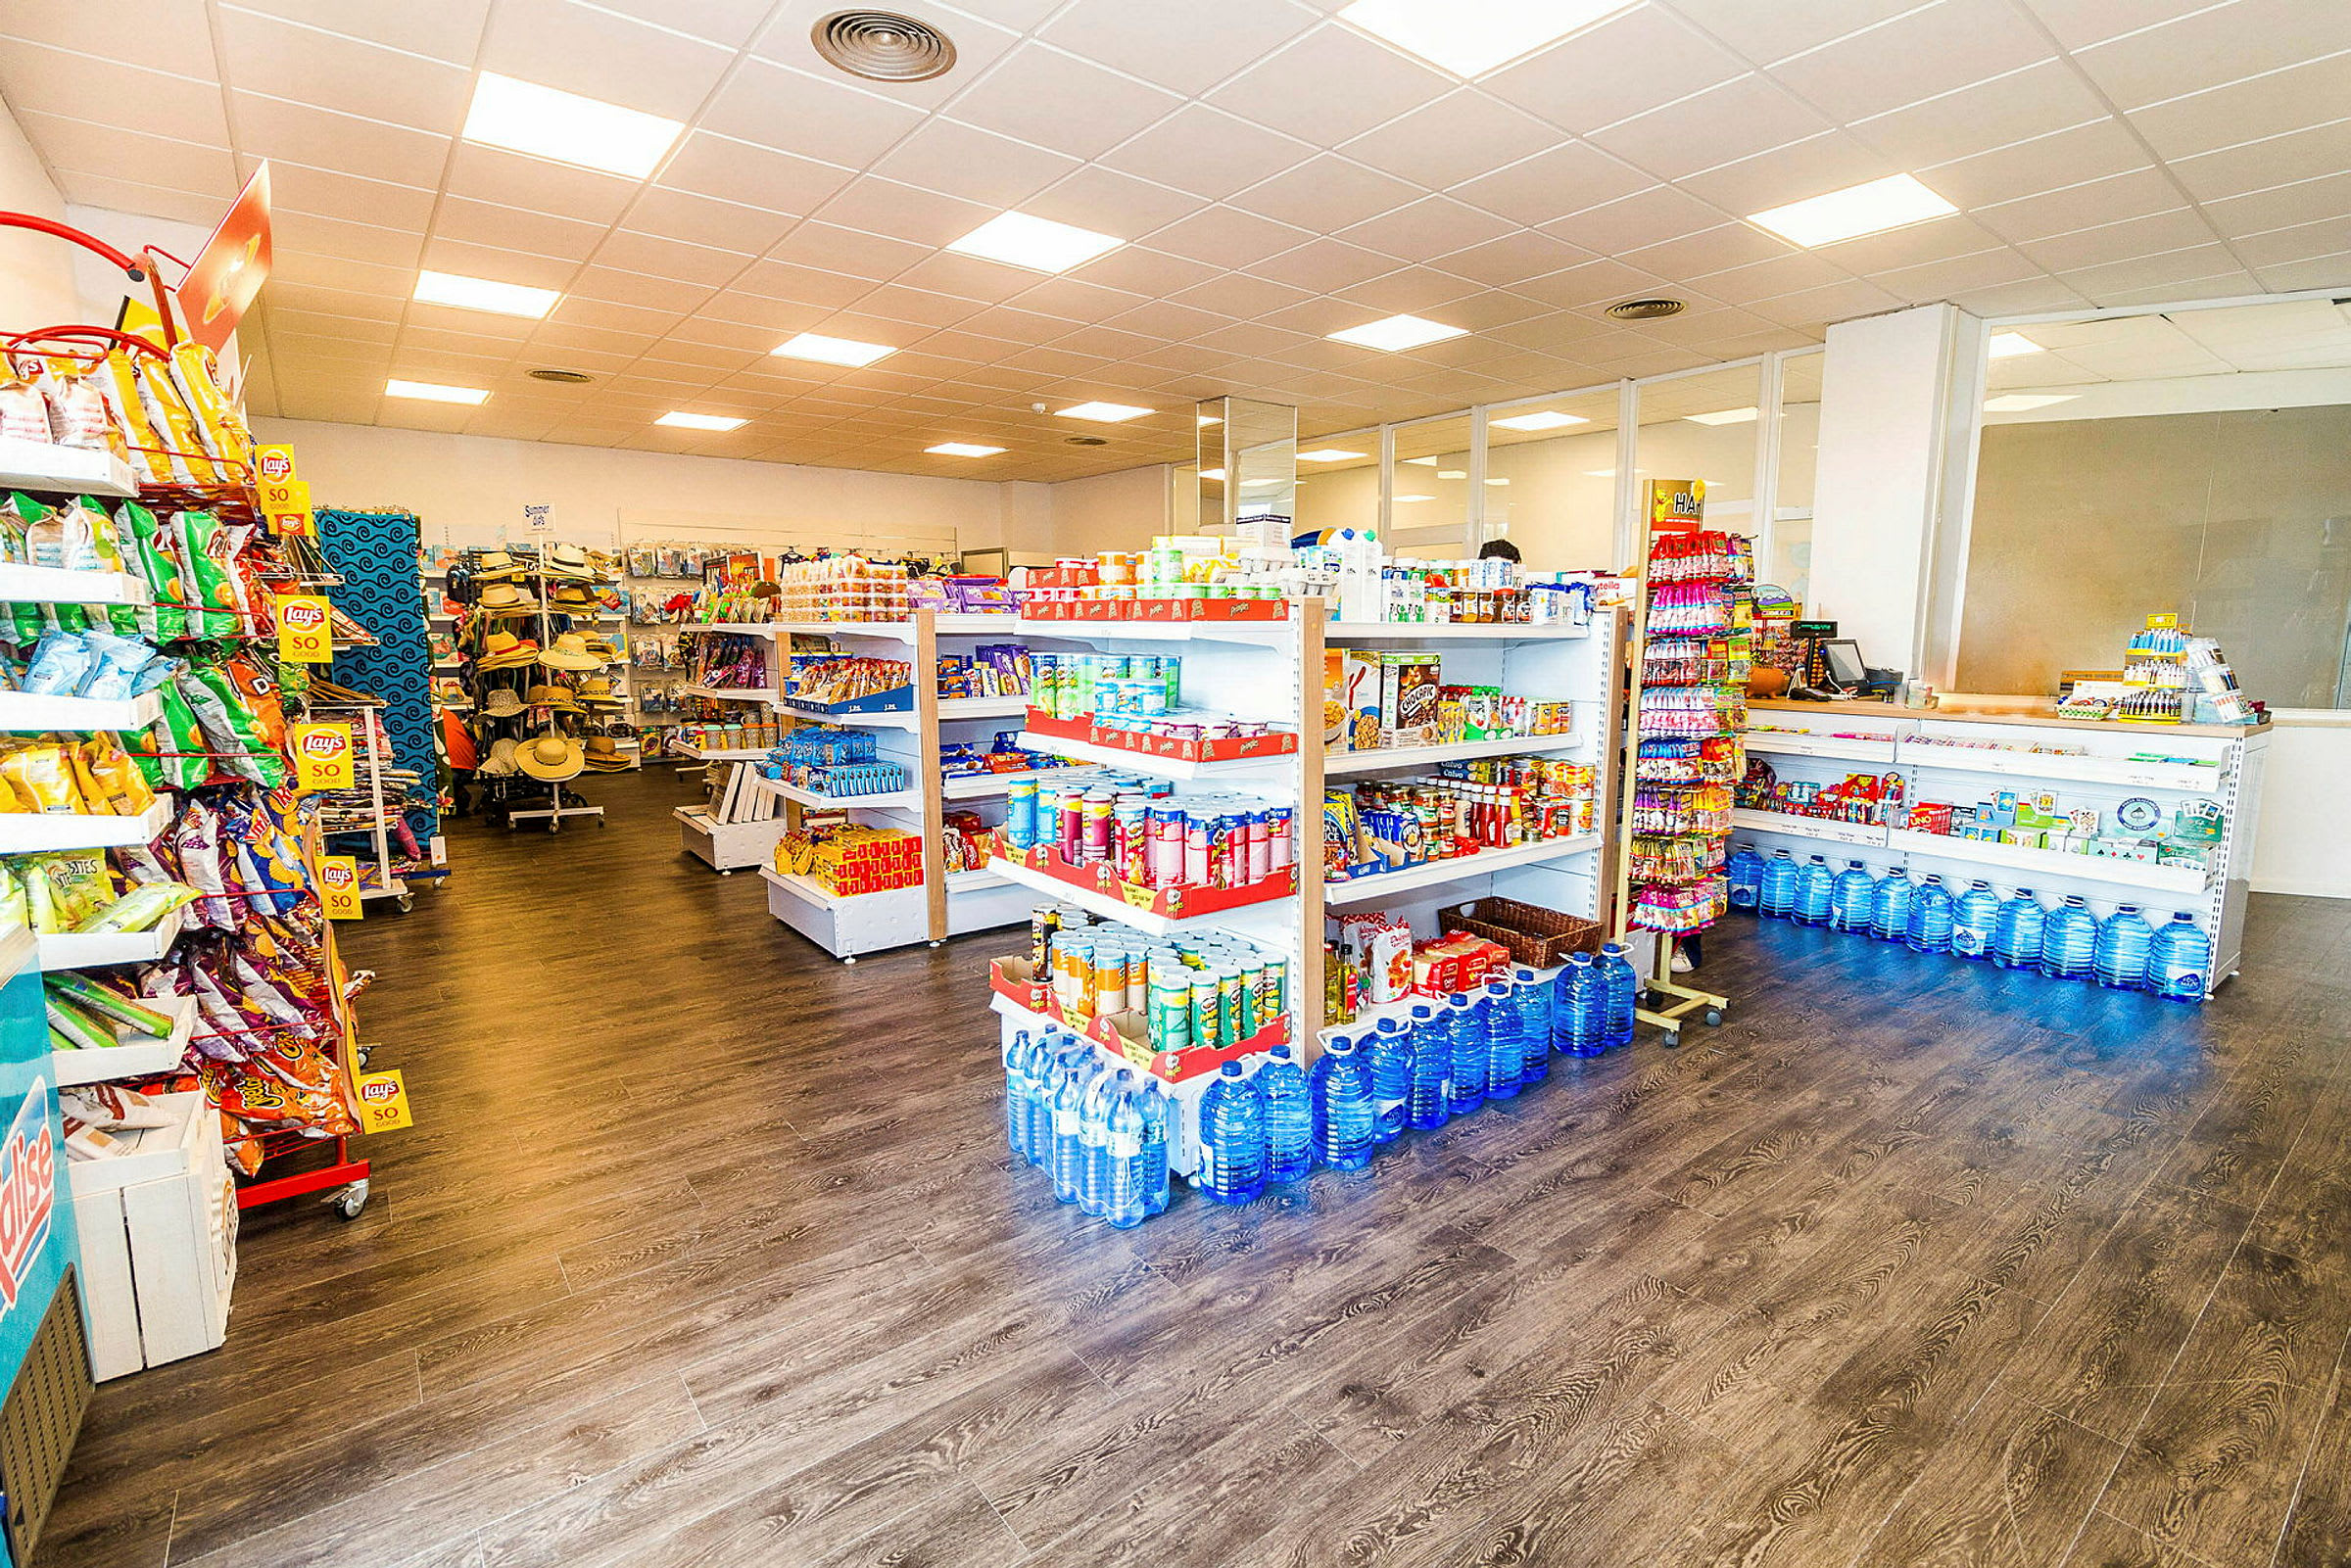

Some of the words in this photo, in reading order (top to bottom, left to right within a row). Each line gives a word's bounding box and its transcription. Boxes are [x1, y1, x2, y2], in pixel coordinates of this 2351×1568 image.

[268, 488, 289, 501] SO
[292, 637, 319, 650] SO
[312, 764, 341, 778] SO
[1443, 769, 1464, 779] Calvo
[1910, 815, 1932, 827] UNO
[331, 895, 352, 908] SO
[373, 1107, 399, 1121] SO
[0, 1124, 53, 1263] alise
